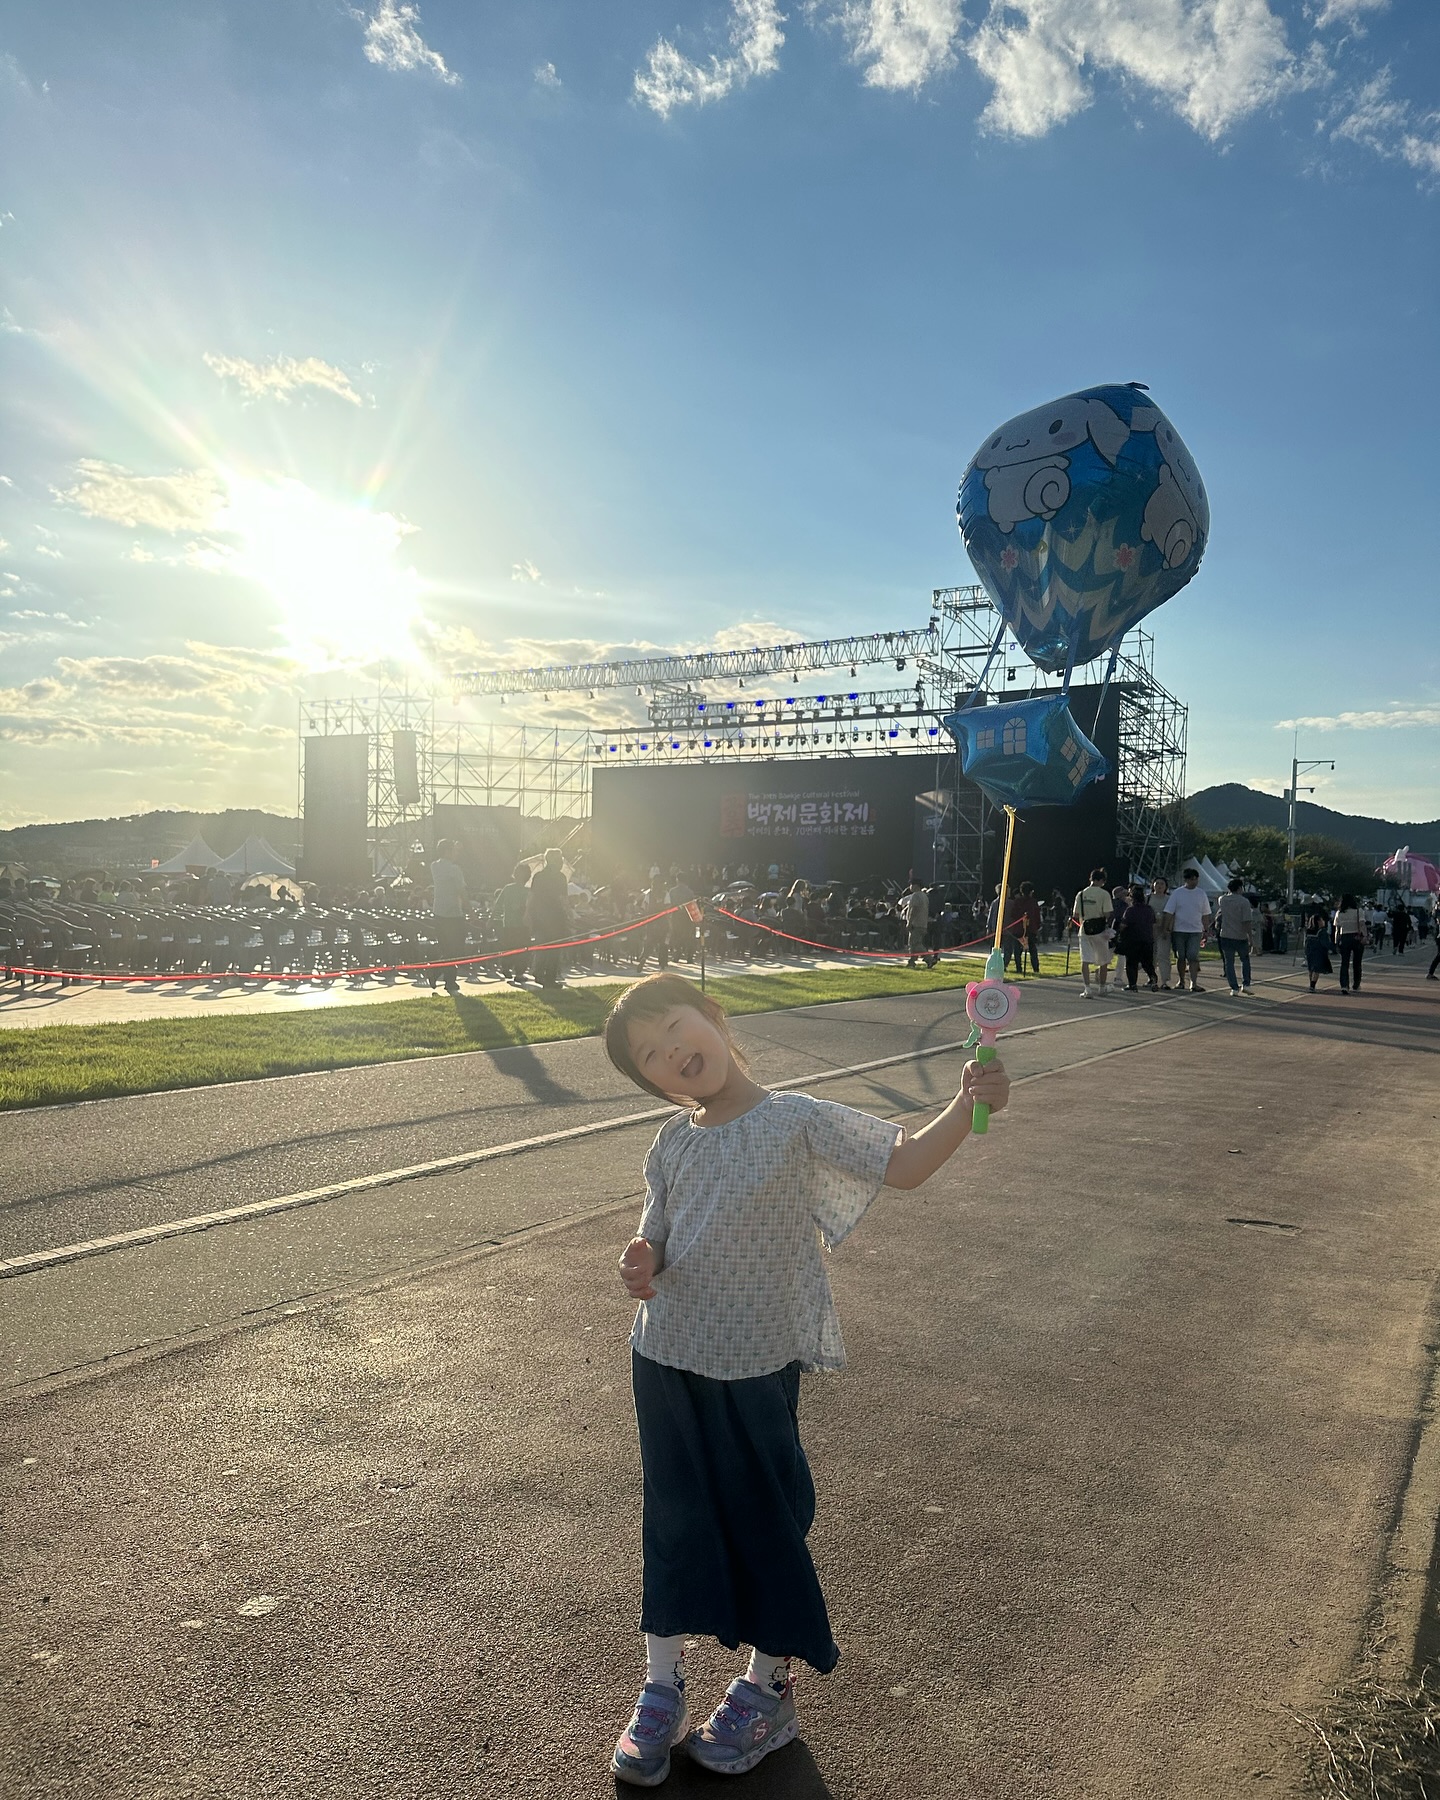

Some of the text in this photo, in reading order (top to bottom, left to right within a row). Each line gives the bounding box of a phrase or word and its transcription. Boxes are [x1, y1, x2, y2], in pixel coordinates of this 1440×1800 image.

[802, 790, 830, 799] Cultural
[831, 788, 860, 798] Festival
[747, 802, 869, 825] 백제문화제
